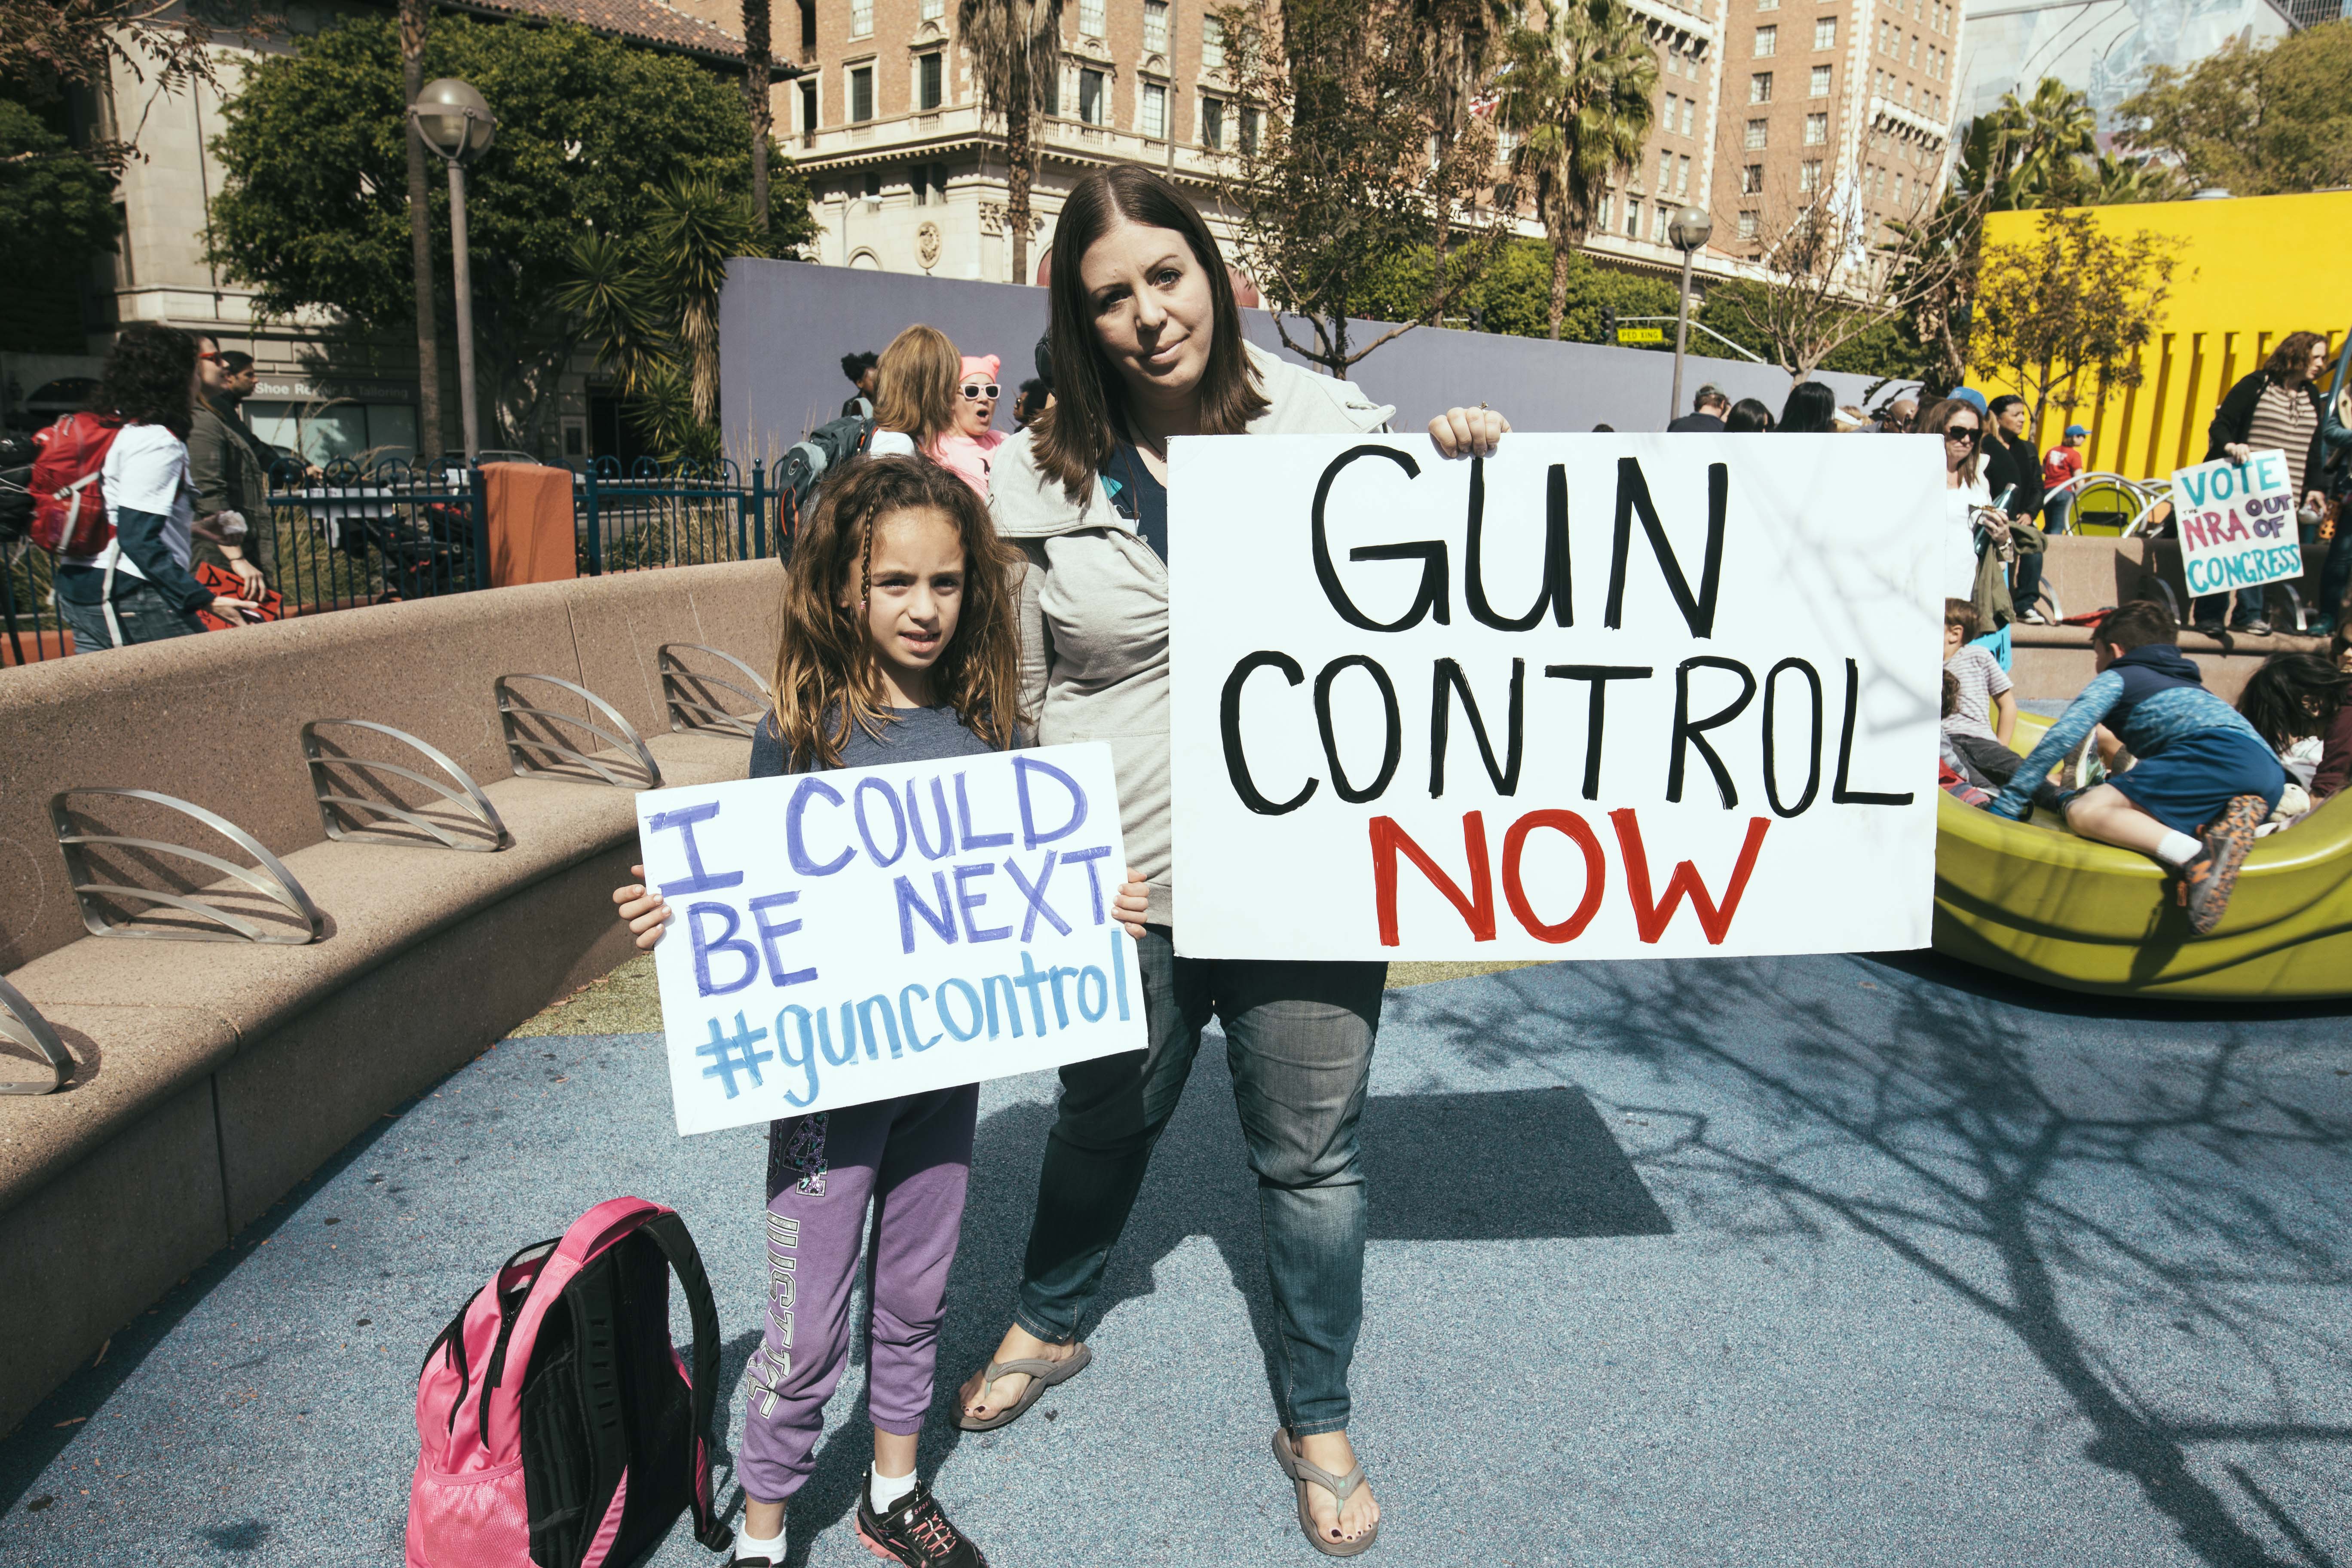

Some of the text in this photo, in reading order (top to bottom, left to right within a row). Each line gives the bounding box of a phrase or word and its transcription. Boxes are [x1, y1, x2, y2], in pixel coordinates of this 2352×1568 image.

[254, 382, 289, 395] Shoe
[357, 385, 409, 399] Tailoring
[2180, 457, 2281, 507] VOTE
[2245, 494, 2292, 517] OUT
[2253, 515, 2285, 539] OF
[1311, 444, 1727, 639] GUN
[2182, 509, 2251, 552] NRA
[2187, 544, 2301, 593] CONGRESS
[1220, 650, 1914, 818] CONTROL
[644, 754, 1088, 897] I COULD
[686, 845, 1112, 998] BE NEXT
[1369, 808, 1771, 946] NOW
[695, 927, 1130, 1108] #guncontrol
